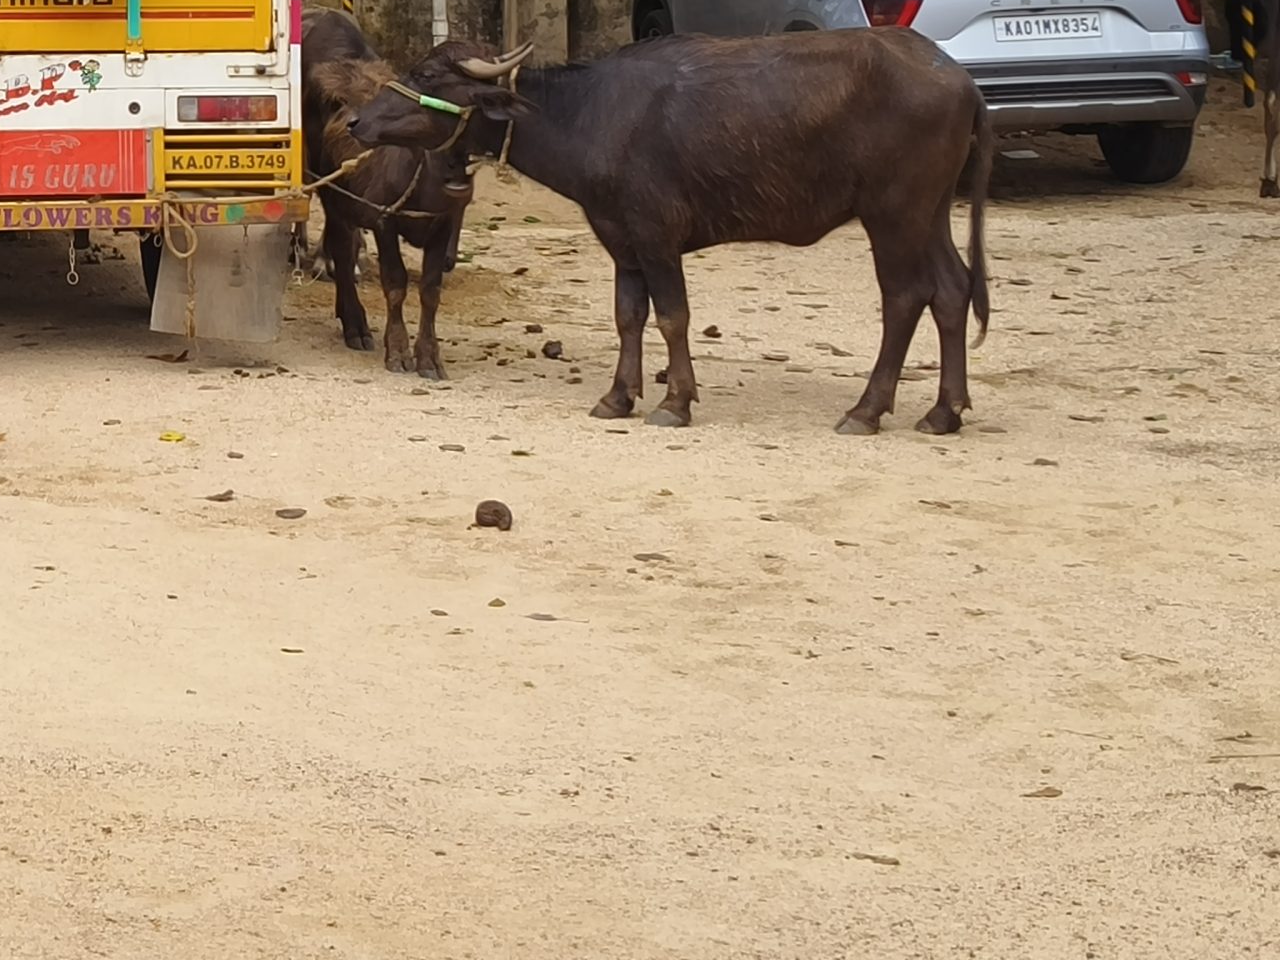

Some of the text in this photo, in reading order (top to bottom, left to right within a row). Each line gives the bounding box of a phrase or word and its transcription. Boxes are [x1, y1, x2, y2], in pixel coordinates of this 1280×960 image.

[1004, 17, 1100, 37] KA01MX8354
[171, 154, 287, 171] KA.07.B.3749
[9, 165, 35, 189] IS
[44, 163, 118, 189] GURU
